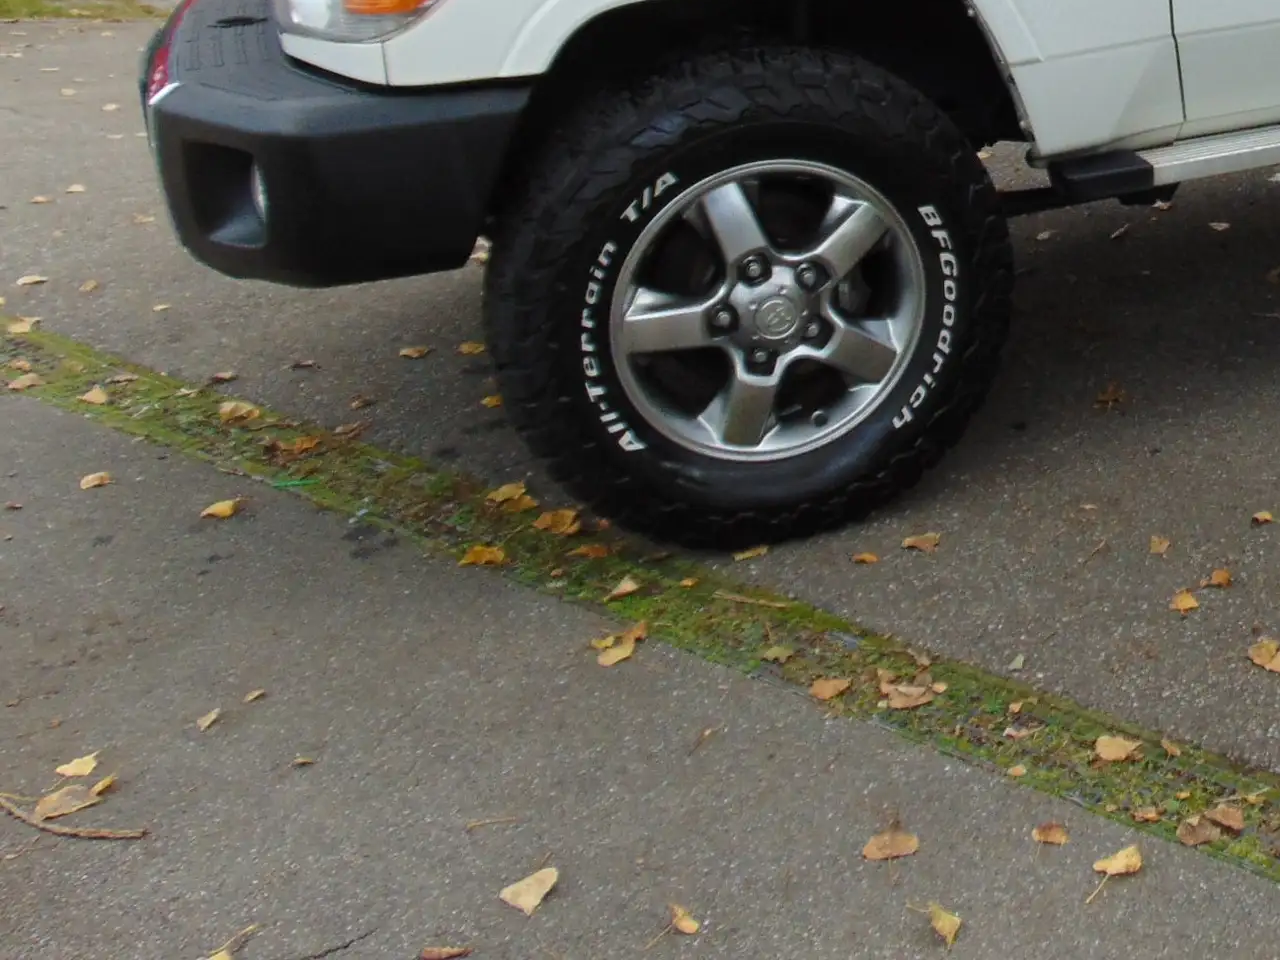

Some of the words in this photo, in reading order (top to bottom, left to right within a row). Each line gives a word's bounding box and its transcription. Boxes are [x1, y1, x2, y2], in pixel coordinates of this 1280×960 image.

[619, 170, 681, 224] T/A
[580, 240, 649, 453] All-Terrain
[891, 204, 959, 430] BFGoodrich
